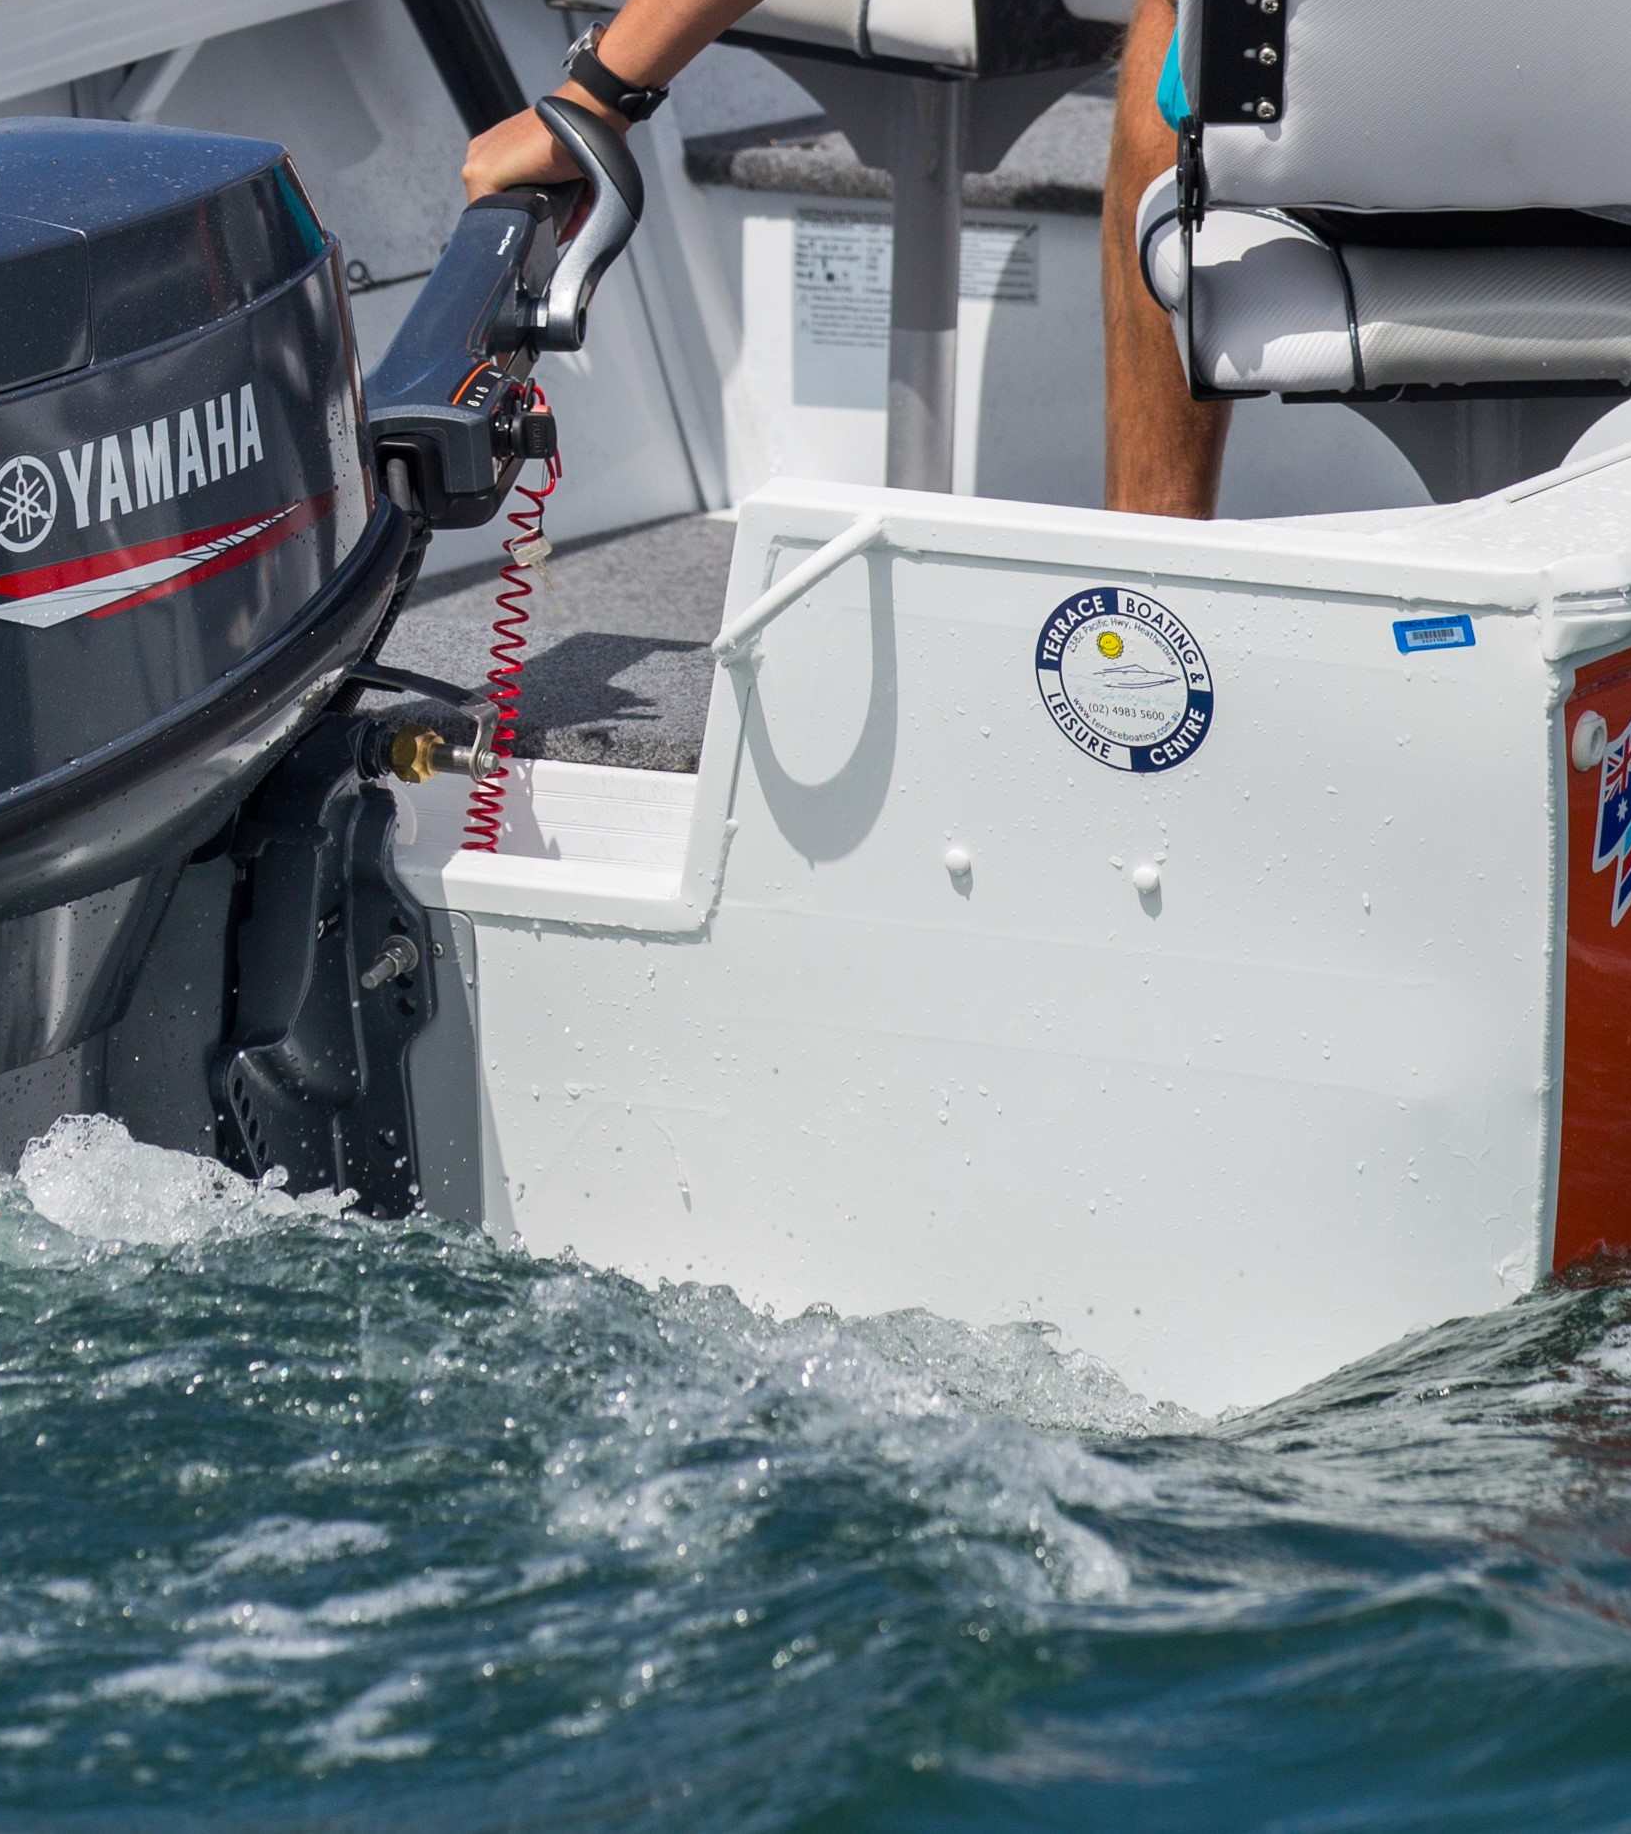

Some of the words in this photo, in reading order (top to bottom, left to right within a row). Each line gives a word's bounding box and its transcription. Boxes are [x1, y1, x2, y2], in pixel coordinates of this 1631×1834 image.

[58, 383, 265, 530] YAMAHA
[1043, 594, 1106, 663] TERRACE
[1126, 597, 1199, 665] BOATING
[1189, 671, 1205, 684] &
[1047, 692, 1112, 759] LEISURE
[1149, 707, 1206, 765] CENTRE
[1088, 703, 1109, 717] (02)
[1112, 707, 1137, 719] 4983
[1140, 709, 1165, 721] 5600
